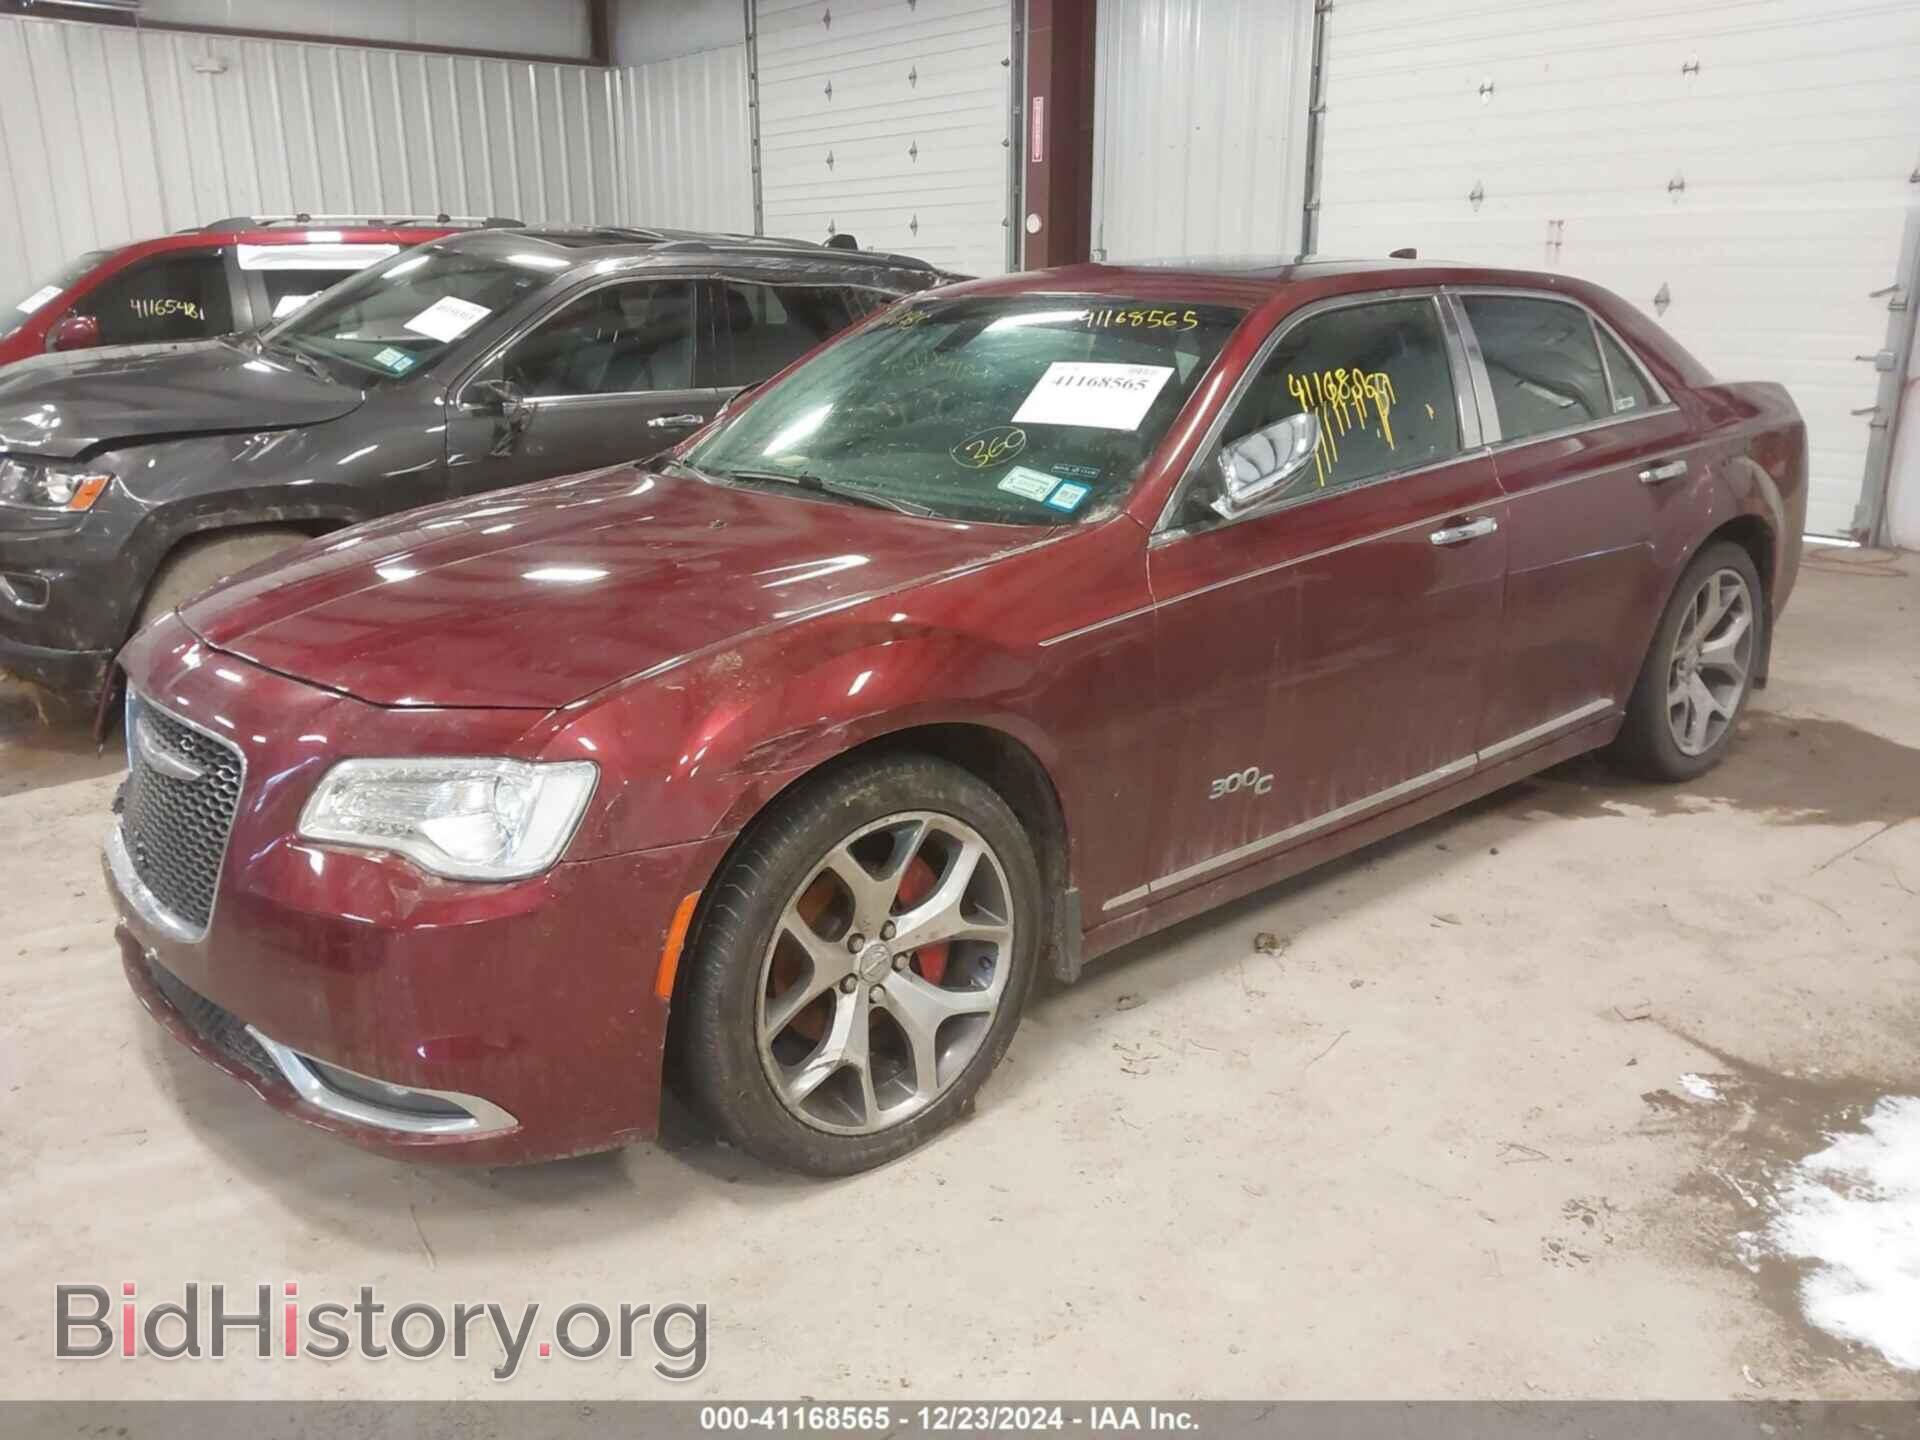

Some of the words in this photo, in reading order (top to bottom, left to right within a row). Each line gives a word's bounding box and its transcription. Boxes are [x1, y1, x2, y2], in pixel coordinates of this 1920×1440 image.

[1081, 309, 1198, 332] 41168565
[1050, 374, 1150, 392] 41168565
[1208, 766, 1275, 800] 300C
